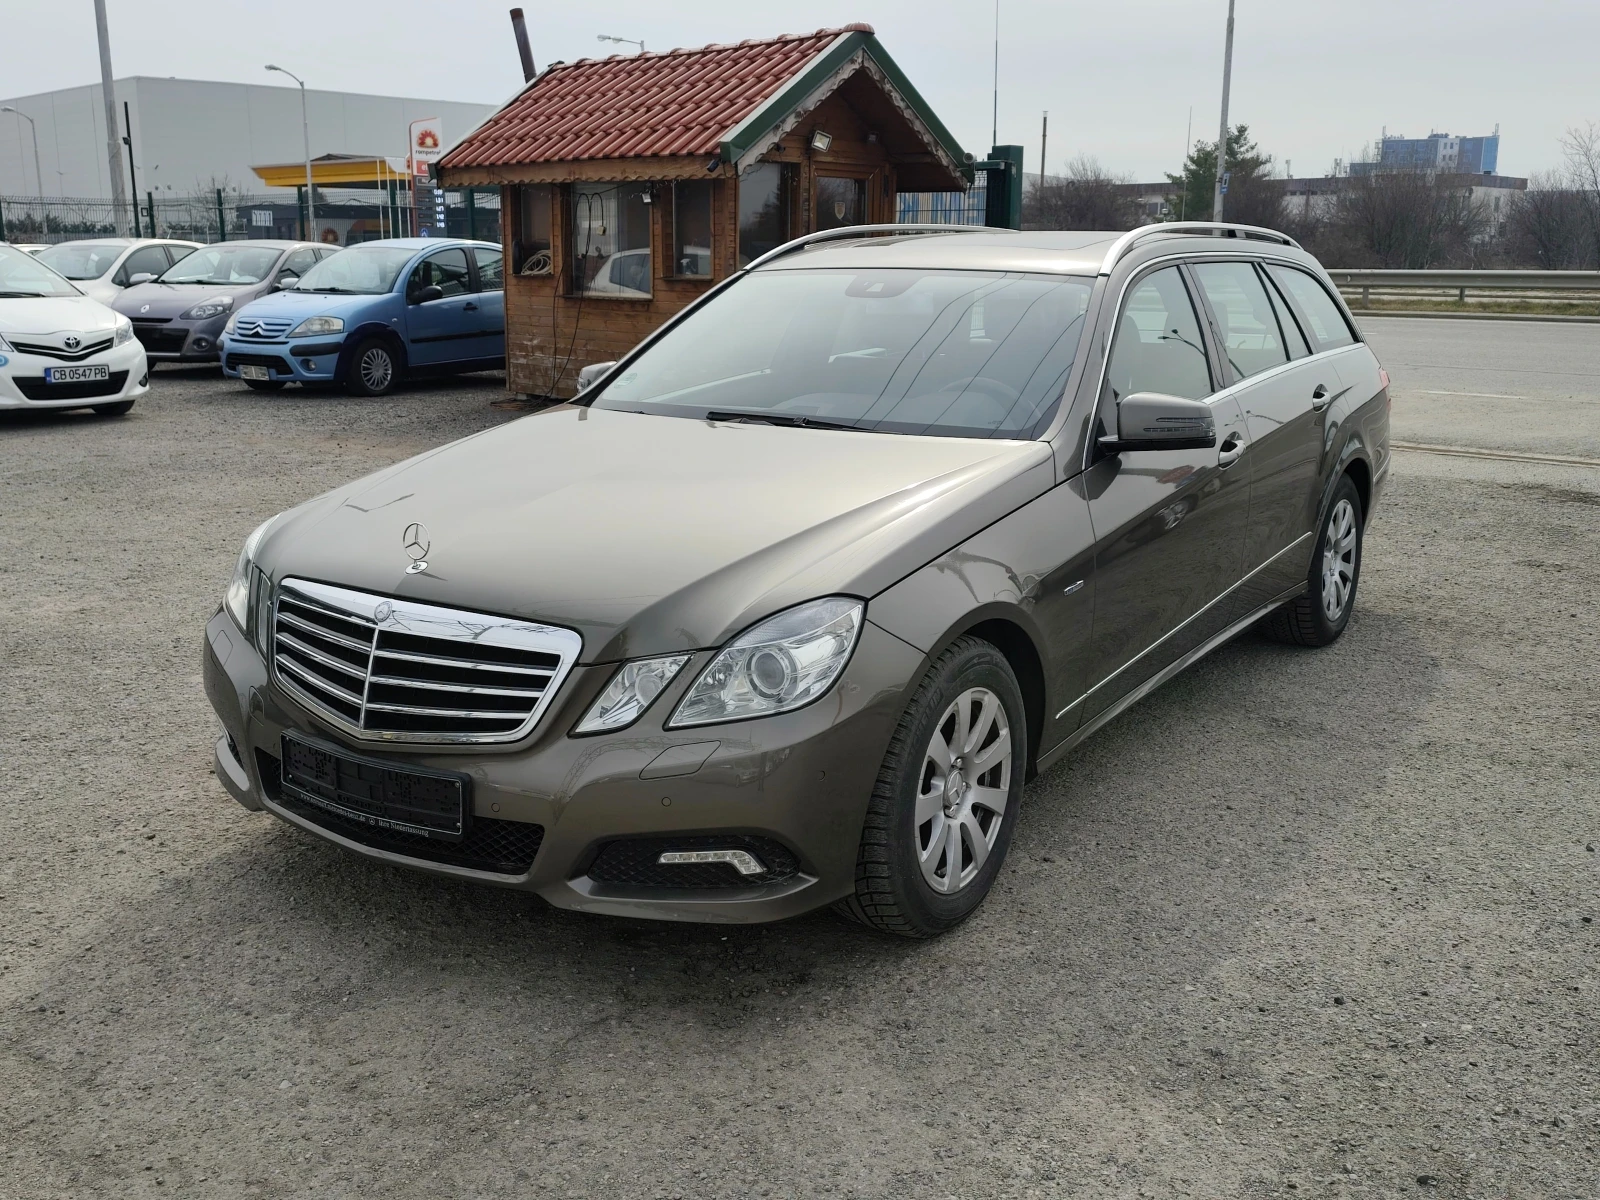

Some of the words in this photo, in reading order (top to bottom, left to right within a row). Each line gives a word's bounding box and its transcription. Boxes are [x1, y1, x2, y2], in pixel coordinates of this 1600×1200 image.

[53, 369, 67, 381] CB
[68, 368, 93, 380] 0547
[94, 367, 107, 378] PB
[378, 819, 390, 828] Ihre
[390, 822, 429, 838] Niederlassung
